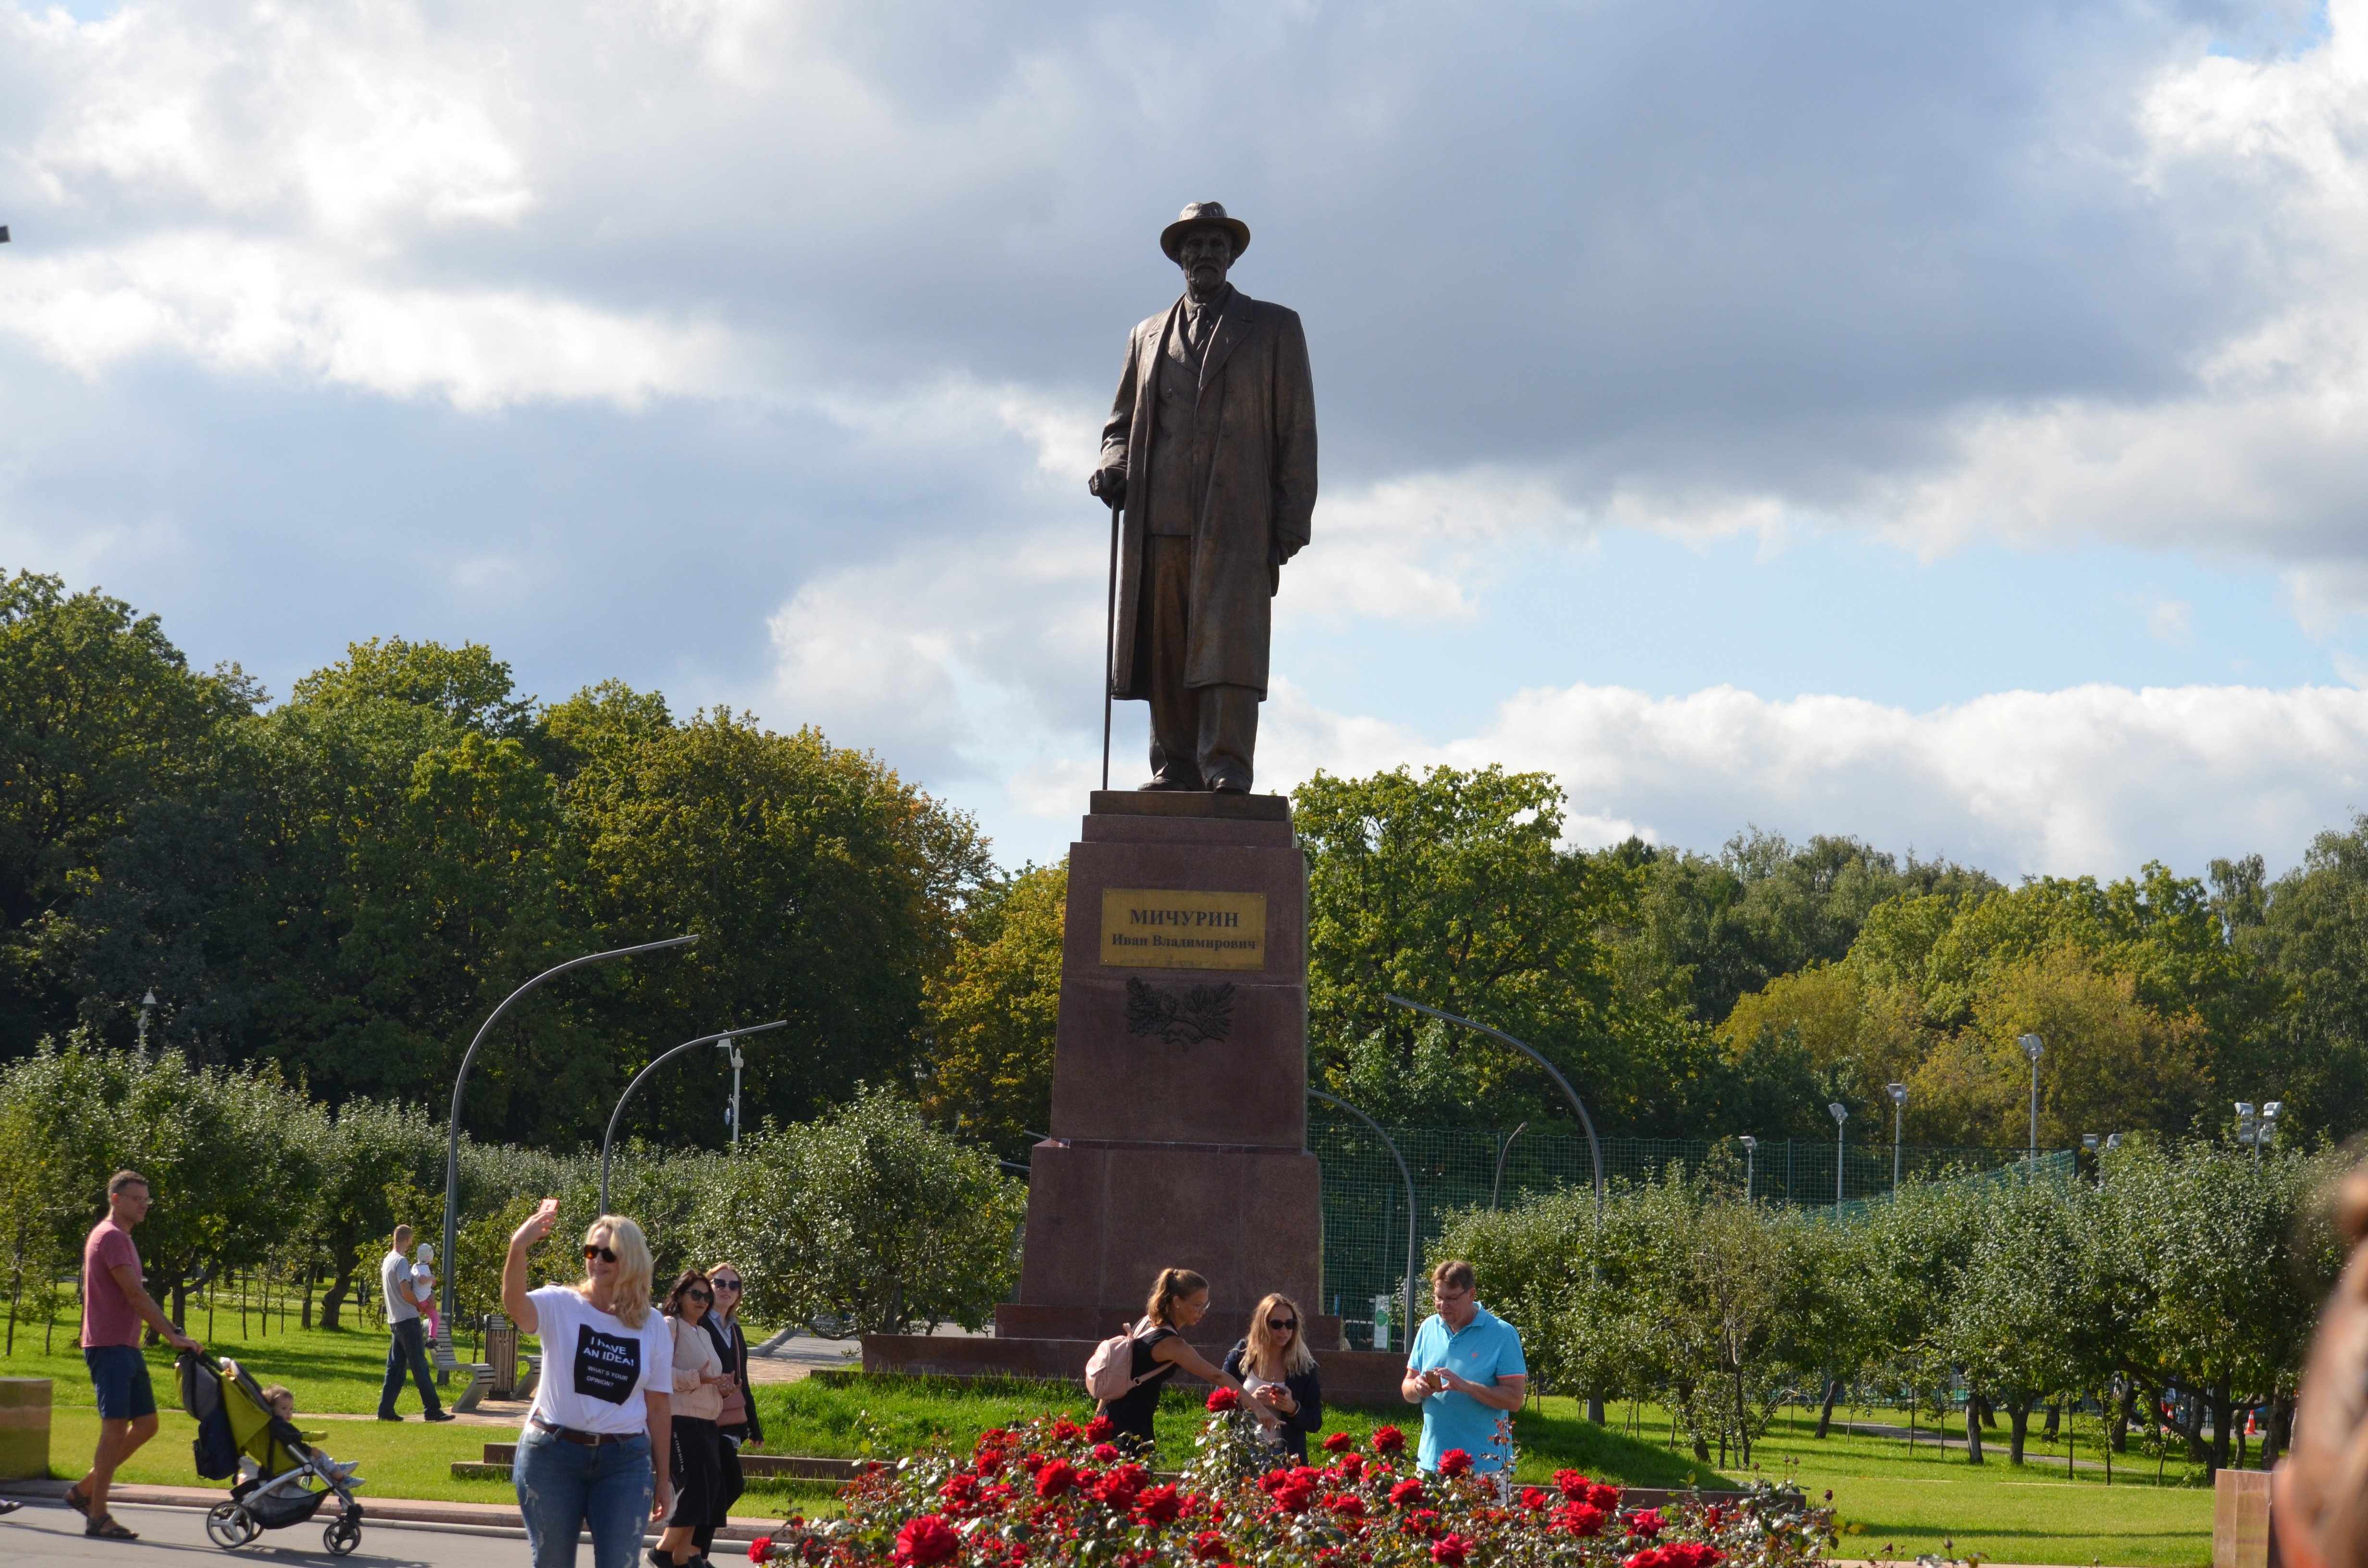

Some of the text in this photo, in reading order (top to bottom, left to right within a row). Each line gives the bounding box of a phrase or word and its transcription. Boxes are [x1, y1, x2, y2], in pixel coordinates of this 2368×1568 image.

[1130, 909, 1239, 927] МИЧУРИН
[1112, 933, 1256, 951] Иван Владимирович
[591, 1336, 627, 1355] I HAVE
[583, 1348, 634, 1366] AN IDEA!
[586, 1375, 614, 1387] OPINION?
[611, 1372, 629, 1381] YOUR
